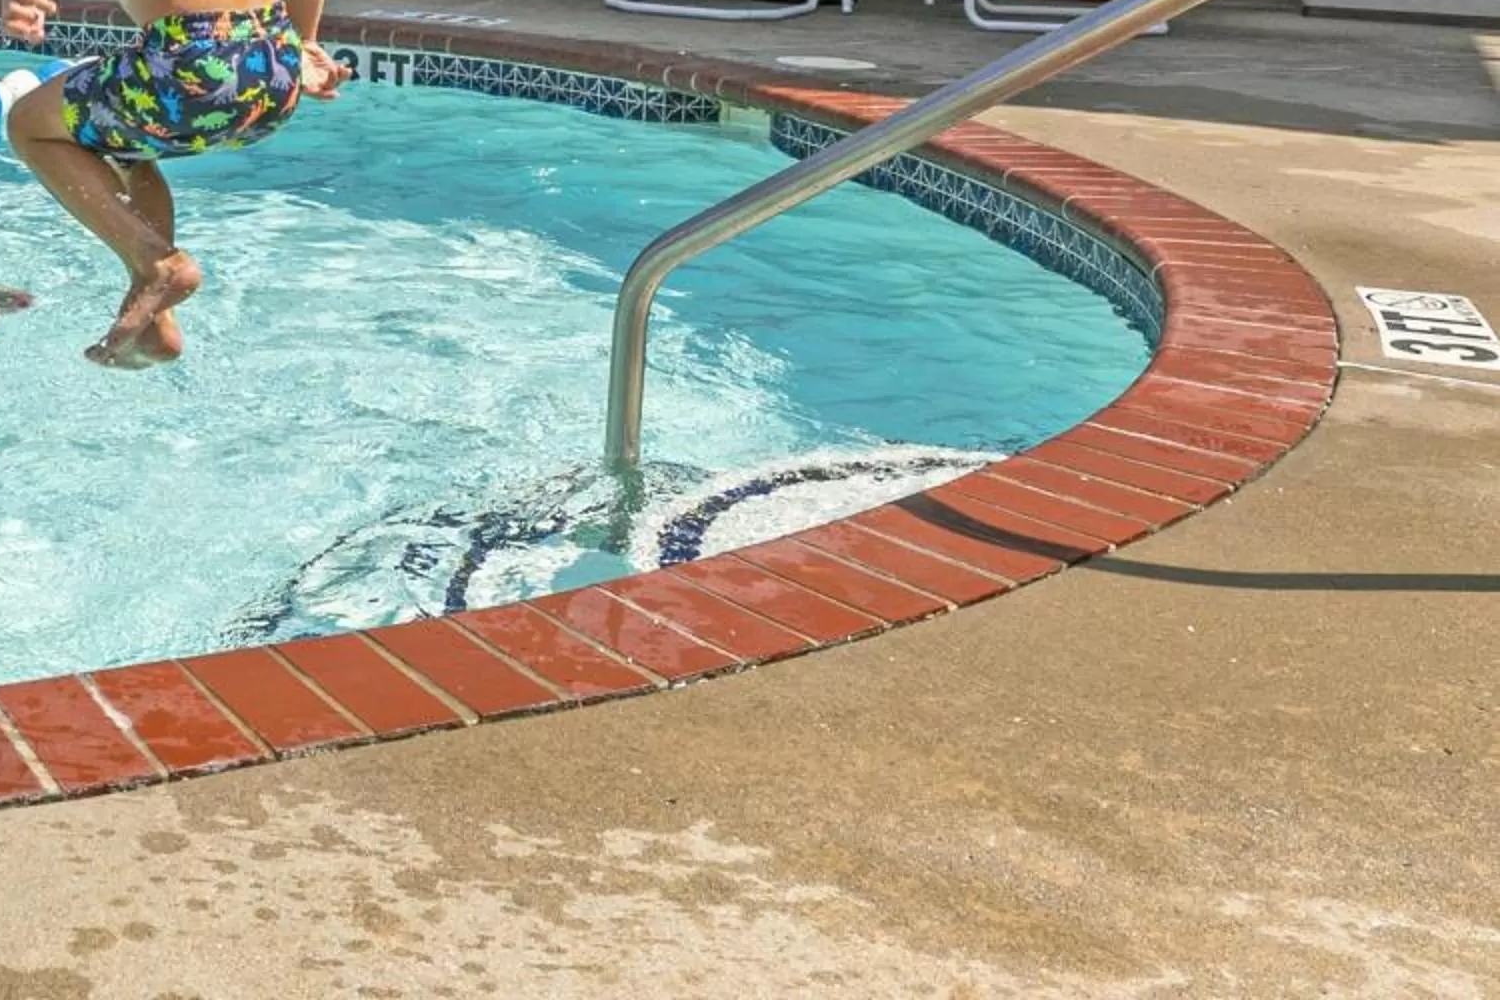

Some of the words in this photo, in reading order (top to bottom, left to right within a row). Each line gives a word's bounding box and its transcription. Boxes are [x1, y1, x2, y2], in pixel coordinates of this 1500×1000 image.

[370, 52, 411, 87] FT
[1380, 310, 1491, 341] FT
[1389, 339, 1499, 362] 3
